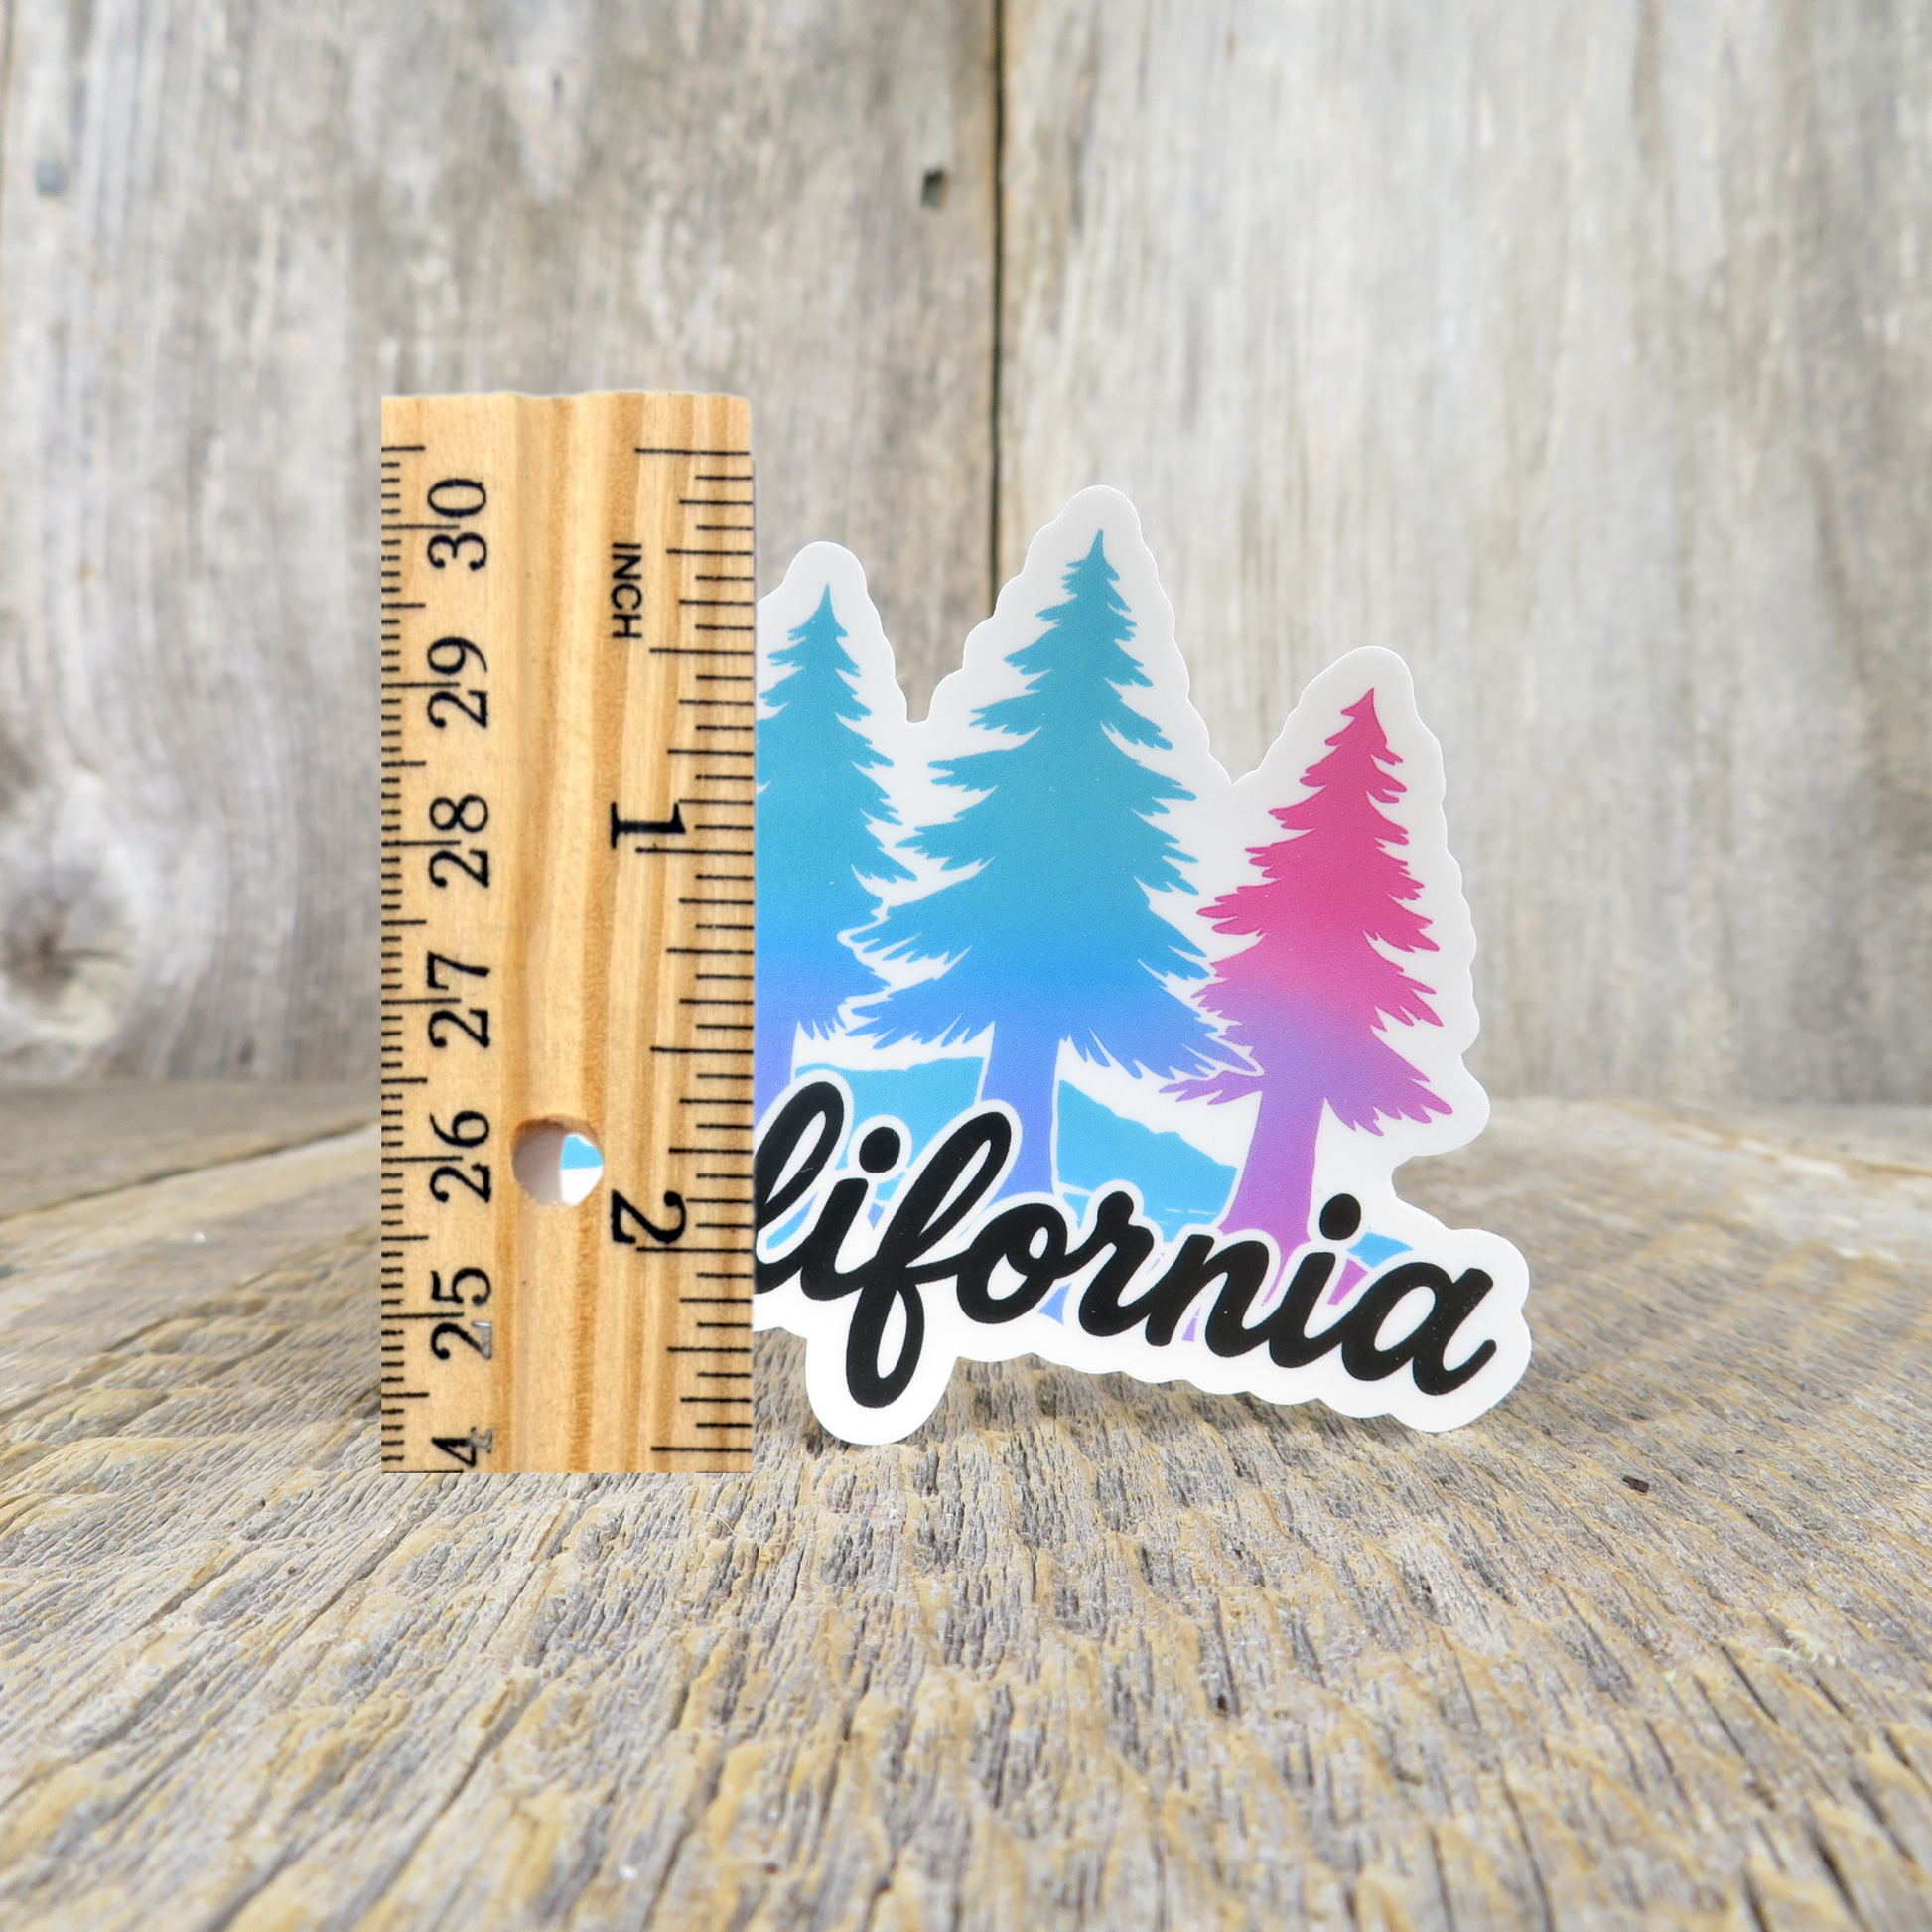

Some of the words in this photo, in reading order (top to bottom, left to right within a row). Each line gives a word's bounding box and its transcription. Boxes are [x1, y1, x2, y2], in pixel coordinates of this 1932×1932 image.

[427, 477, 488, 572] 30
[611, 542, 643, 640] INCH
[426, 635, 489, 729] 29
[428, 793, 490, 889] 28
[610, 801, 687, 850] 1
[426, 951, 491, 1049] 27
[429, 1110, 492, 1203] 26
[610, 1189, 688, 1246] 2
[430, 1266, 493, 1361] 25
